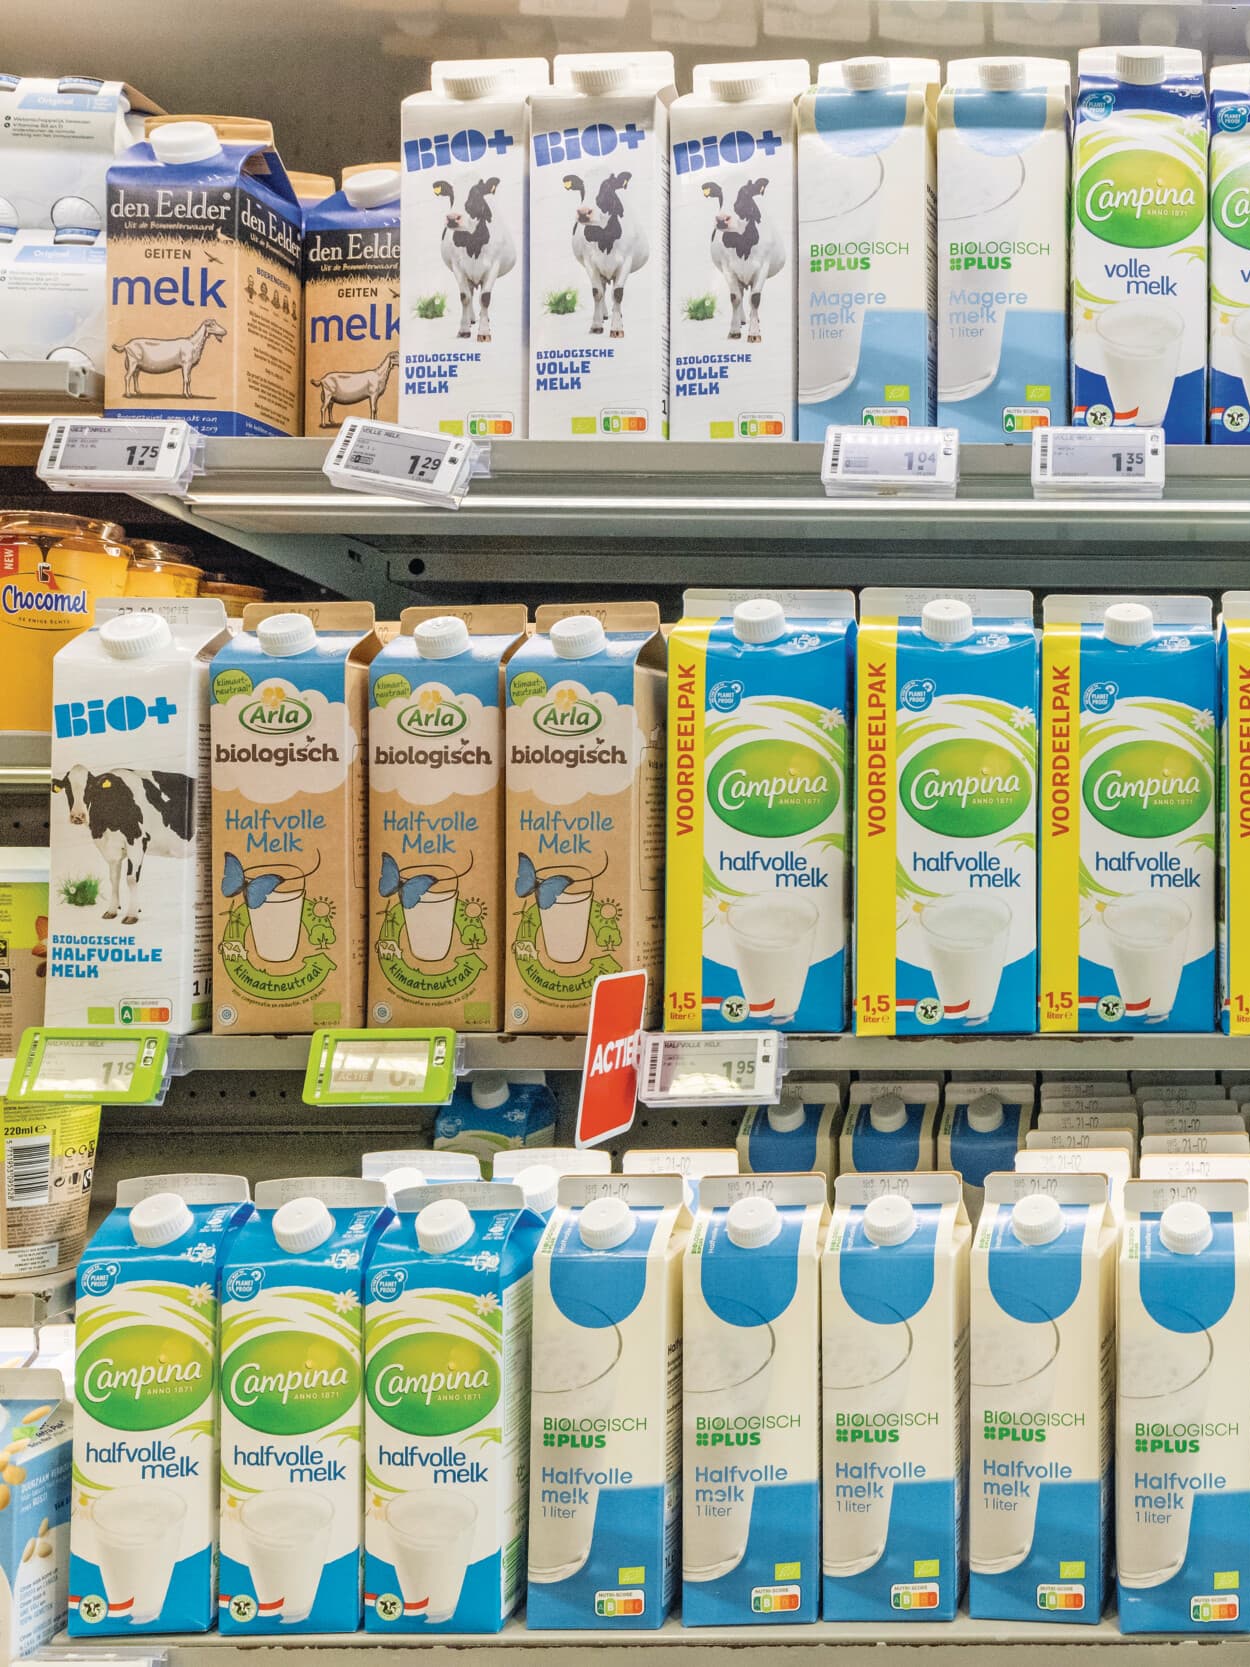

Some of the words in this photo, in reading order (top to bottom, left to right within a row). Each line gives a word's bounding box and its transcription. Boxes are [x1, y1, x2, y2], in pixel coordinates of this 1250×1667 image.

[111, 190, 150, 218] den
[157, 190, 230, 220] Eelder
[1086, 178, 1196, 222] Campina
[145, 248, 191, 260] GEITEN
[309, 235, 342, 262] den
[825, 257, 871, 271] PLUS
[1104, 258, 1150, 278] volle
[112, 267, 226, 308] melk
[338, 288, 378, 298] GEITEN
[1127, 277, 1178, 296] melk
[810, 290, 886, 308] Magere
[810, 308, 856, 324] melk
[818, 326, 844, 340] liter
[405, 353, 482, 364] BIOLOGISCHE
[536, 348, 614, 360] BIOLOGISCHE
[676, 354, 752, 364] BIOLOGISCHE
[405, 365, 458, 380] VOLLE
[536, 360, 590, 375] VOLLE
[676, 366, 729, 380] VOLLE
[405, 380, 449, 394] MELK
[536, 376, 582, 392] MELK
[676, 382, 720, 396] MELK
[126, 446, 159, 466] 1.75
[408, 455, 442, 476] 1.29
[904, 452, 936, 471] 1.04
[1112, 452, 1144, 472] 1.35
[4, 548, 14, 570] NEW
[2, 584, 88, 614] Chocomel
[249, 708, 298, 725] Arla
[408, 709, 454, 727] Arla
[543, 710, 590, 726] Arla
[215, 744, 339, 766] biologisch
[374, 746, 492, 768] biologisch
[510, 746, 627, 768] biologisch
[677, 664, 696, 836] VOORDEELPAK
[868, 662, 887, 837] VOORDEELPAK
[1052, 664, 1071, 837] VOORDEELPAK
[718, 768, 828, 810] Campina
[910, 768, 1020, 810] Campina
[1094, 770, 1200, 810] Campina
[225, 810, 327, 830] Halfvolle
[384, 810, 479, 832] Halfvolle
[520, 810, 614, 832] Halfvolle
[246, 832, 304, 854] Melk
[402, 834, 456, 854] Melk
[538, 834, 592, 854] Melk
[720, 851, 807, 872] halfvolle
[913, 851, 1000, 872] halfvolle
[1096, 852, 1180, 872] halfvolle
[776, 868, 828, 888] melk
[970, 869, 1020, 888] melk
[1150, 869, 1200, 888] melk
[52, 934, 135, 946] BIOLOGISCHE
[52, 947, 162, 962] HALFVOLLE
[52, 964, 98, 978] MELK
[669, 992, 696, 1012] 1,5
[670, 1012, 686, 1020] liter
[4, 1126, 33, 1136] 220ml
[83, 1354, 201, 1404] Campina
[230, 1360, 348, 1406] Campina
[146, 1387, 171, 1396] ANNO
[558, 1432, 606, 1448] PLUS
[850, 1428, 900, 1444] PLUS
[86, 1440, 176, 1464] halfvolle
[234, 1444, 324, 1466] halfvolle
[142, 1458, 199, 1481] melk
[290, 1461, 346, 1483] melk
[542, 1466, 633, 1485] Halfvolle
[835, 1462, 926, 1480] Halfvolle
[542, 1488, 589, 1505] melk
[836, 1482, 884, 1500] melk
[550, 1505, 576, 1519] liter
